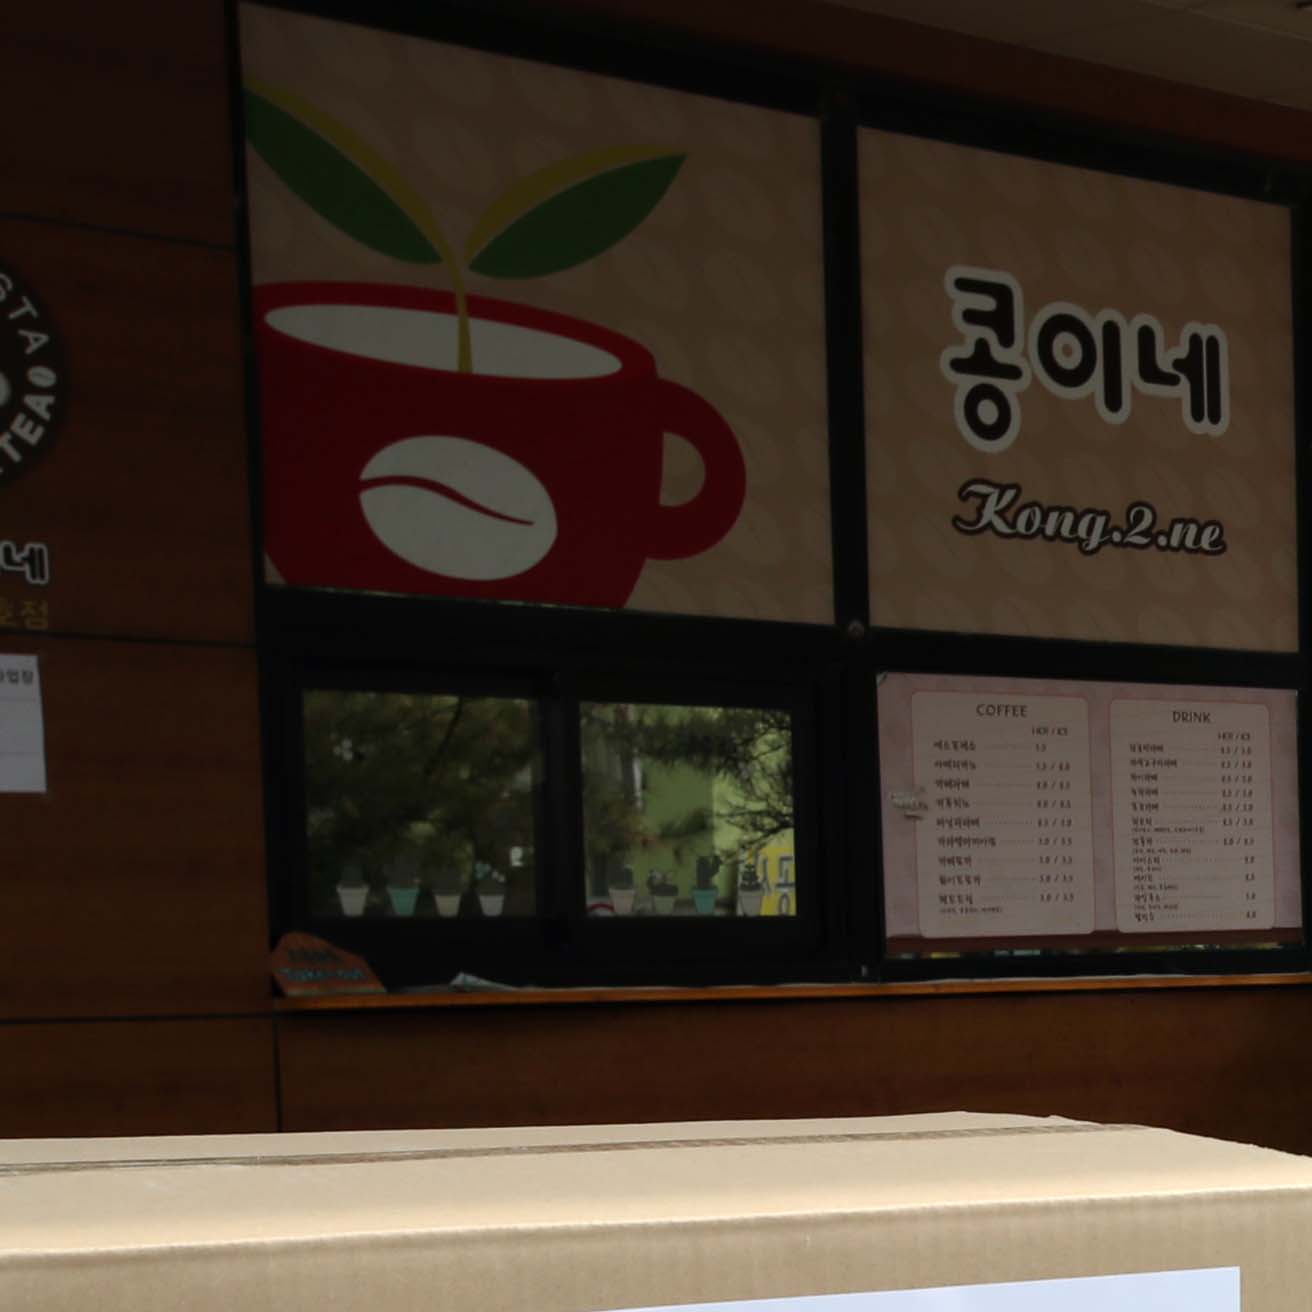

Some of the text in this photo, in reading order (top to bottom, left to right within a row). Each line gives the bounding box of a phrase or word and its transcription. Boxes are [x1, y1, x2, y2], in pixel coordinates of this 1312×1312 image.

[943, 268, 1228, 450] 콩이네
[954, 479, 1227, 556] Kong.2.ne
[976, 703, 1028, 718] COFFEE
[1172, 711, 1211, 724] DRINK
